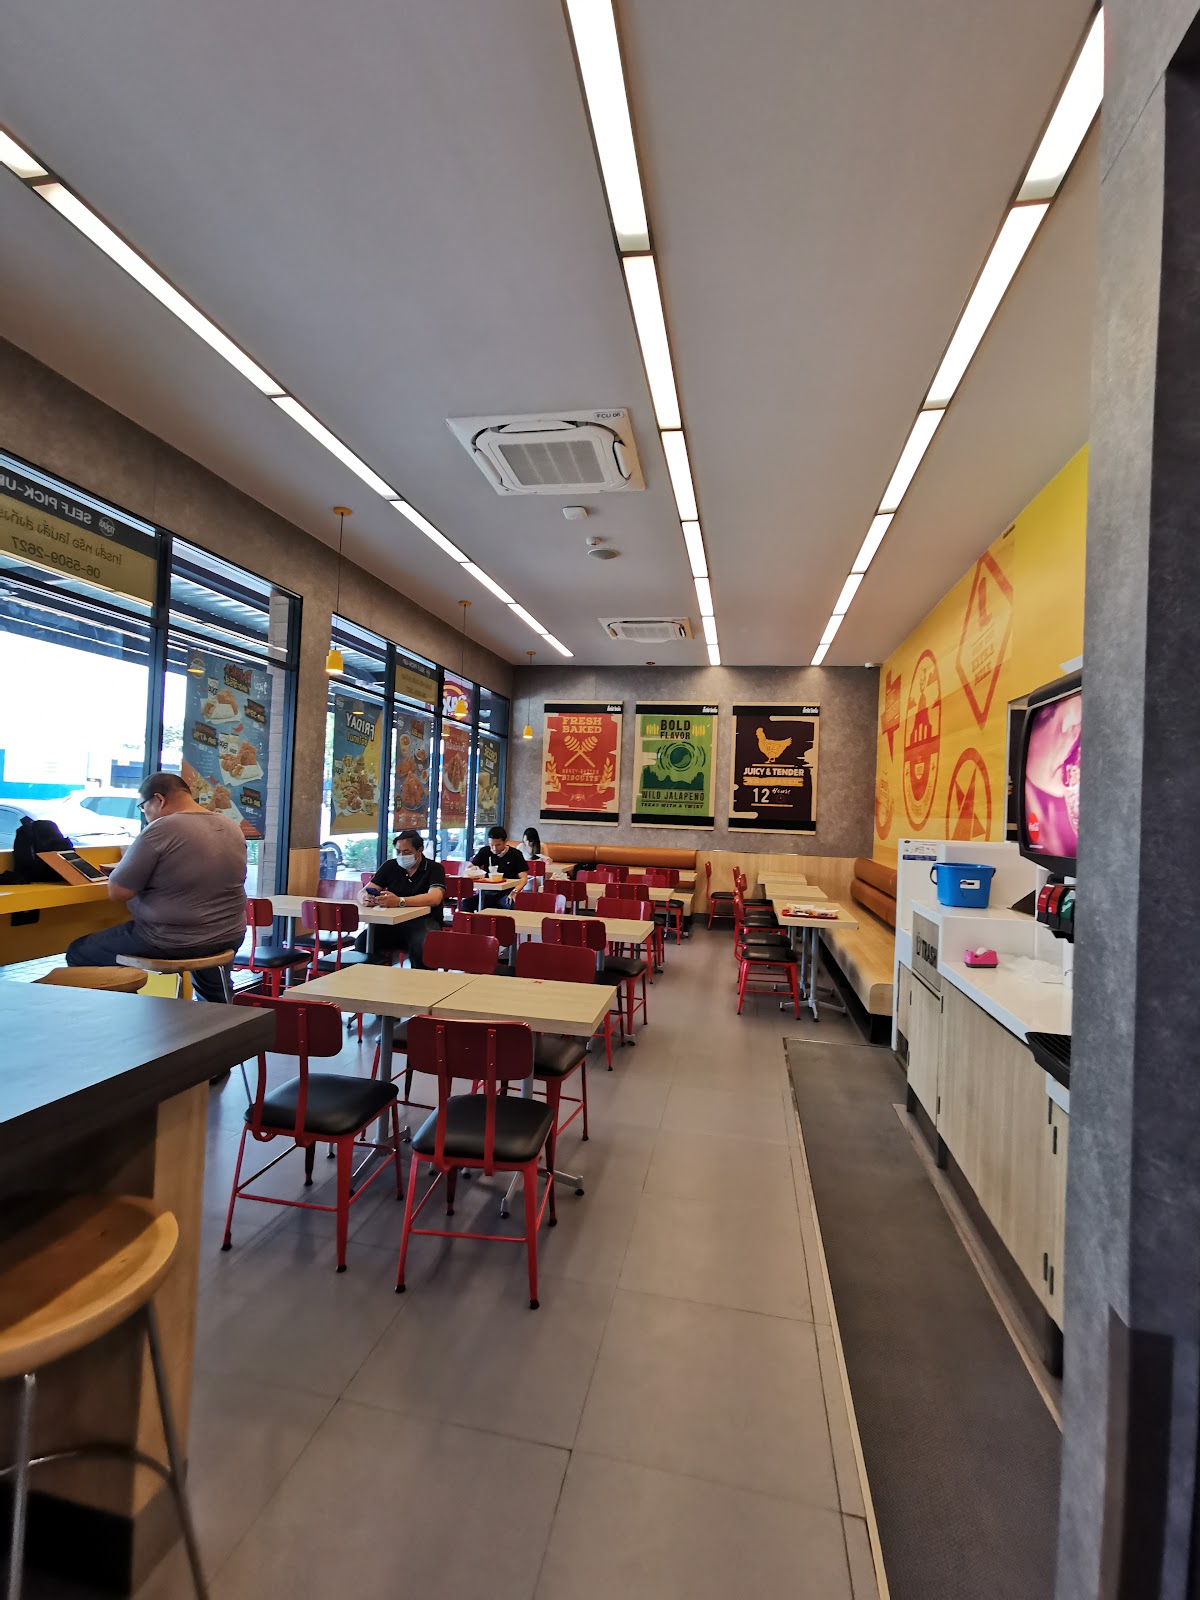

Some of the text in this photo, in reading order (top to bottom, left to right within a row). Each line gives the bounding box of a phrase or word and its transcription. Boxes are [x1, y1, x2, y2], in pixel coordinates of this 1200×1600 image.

[562, 716, 603, 726] FRESH
[660, 719, 691, 731] BOLD
[562, 725, 602, 734] BAKED
[660, 731, 691, 740] FLAVOR
[743, 767, 805, 777] JUICY & TENDER
[561, 774, 599, 782] BISCUITS
[641, 790, 662, 800] WILD
[752, 787, 771, 803] 12
